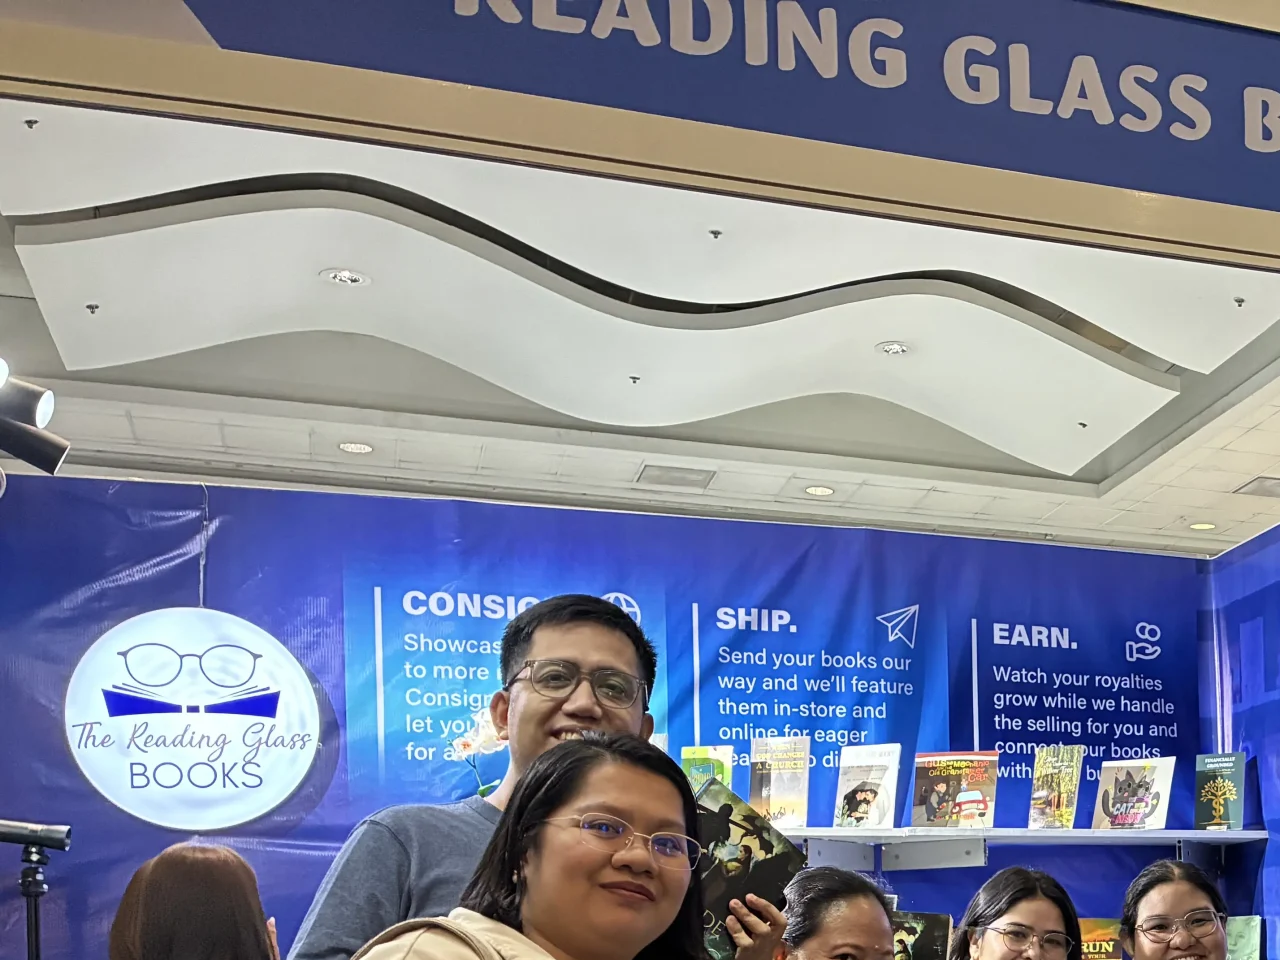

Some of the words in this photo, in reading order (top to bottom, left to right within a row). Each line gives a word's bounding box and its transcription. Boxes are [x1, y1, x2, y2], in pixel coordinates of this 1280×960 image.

[943, 35, 1212, 140] GLASS
[716, 607, 797, 633] SHIP.
[993, 623, 1077, 650] EARN.
[718, 646, 767, 665] Send
[772, 653, 815, 669] your
[821, 650, 878, 669] books
[882, 656, 912, 670] our
[404, 662, 427, 679] to
[433, 665, 489, 680] more
[993, 665, 1048, 685] Watch
[1053, 672, 1090, 695] your
[1095, 673, 1162, 692] royalties
[718, 675, 756, 693] way
[762, 674, 798, 691] and
[804, 675, 845, 692] we'll
[851, 676, 914, 695] feature
[718, 698, 767, 716] them
[774, 699, 847, 717] in-store
[852, 702, 887, 719] and
[993, 693, 1037, 709] grow
[1042, 693, 1087, 710] while
[1091, 697, 1115, 711] we
[1120, 696, 1175, 715] handle
[406, 714, 433, 733] let
[719, 723, 778, 740] online
[783, 724, 809, 738] for
[814, 729, 868, 746] eager
[993, 714, 1022, 732] the
[1027, 715, 1082, 737] selling
[1087, 718, 1109, 735] for
[1113, 722, 1144, 739] you
[1149, 722, 1178, 738] and
[72, 722, 115, 752] The
[127, 721, 231, 762] Reading
[241, 723, 313, 763] Glass
[405, 742, 437, 761] for
[1111, 743, 1161, 759] books
[129, 762, 264, 789] BOOKS
[996, 762, 1032, 778] with
